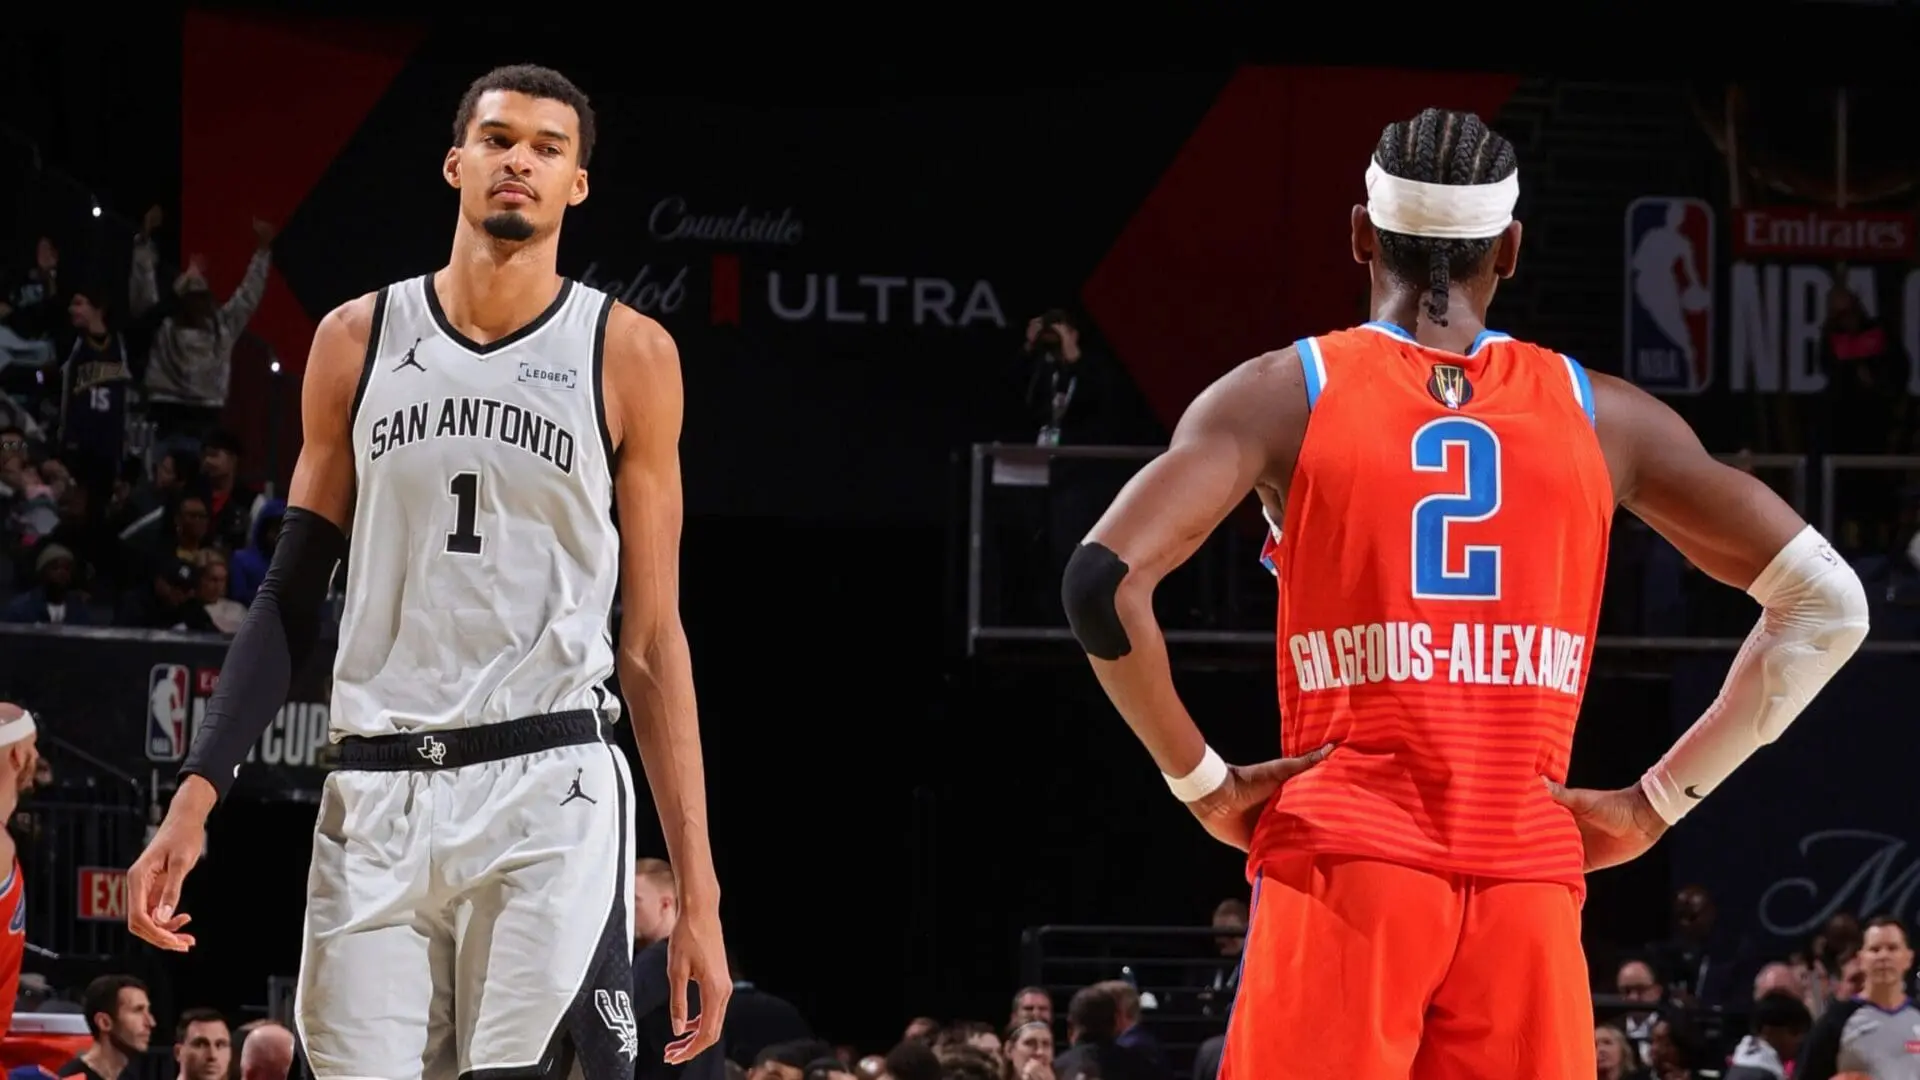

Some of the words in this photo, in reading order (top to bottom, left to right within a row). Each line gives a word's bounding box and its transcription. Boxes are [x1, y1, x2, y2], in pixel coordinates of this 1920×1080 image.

[1743, 210, 1906, 250] Emirates
[767, 271, 1008, 329] ULTRA
[90, 386, 111, 413] 15
[525, 366, 570, 384] LEDGER
[371, 402, 429, 461] SAN
[436, 398, 574, 474] ANTONIO
[446, 472, 482, 554] 1
[1411, 416, 1501, 600] 2
[261, 701, 329, 767] CUP
[91, 872, 128, 917] EXI
